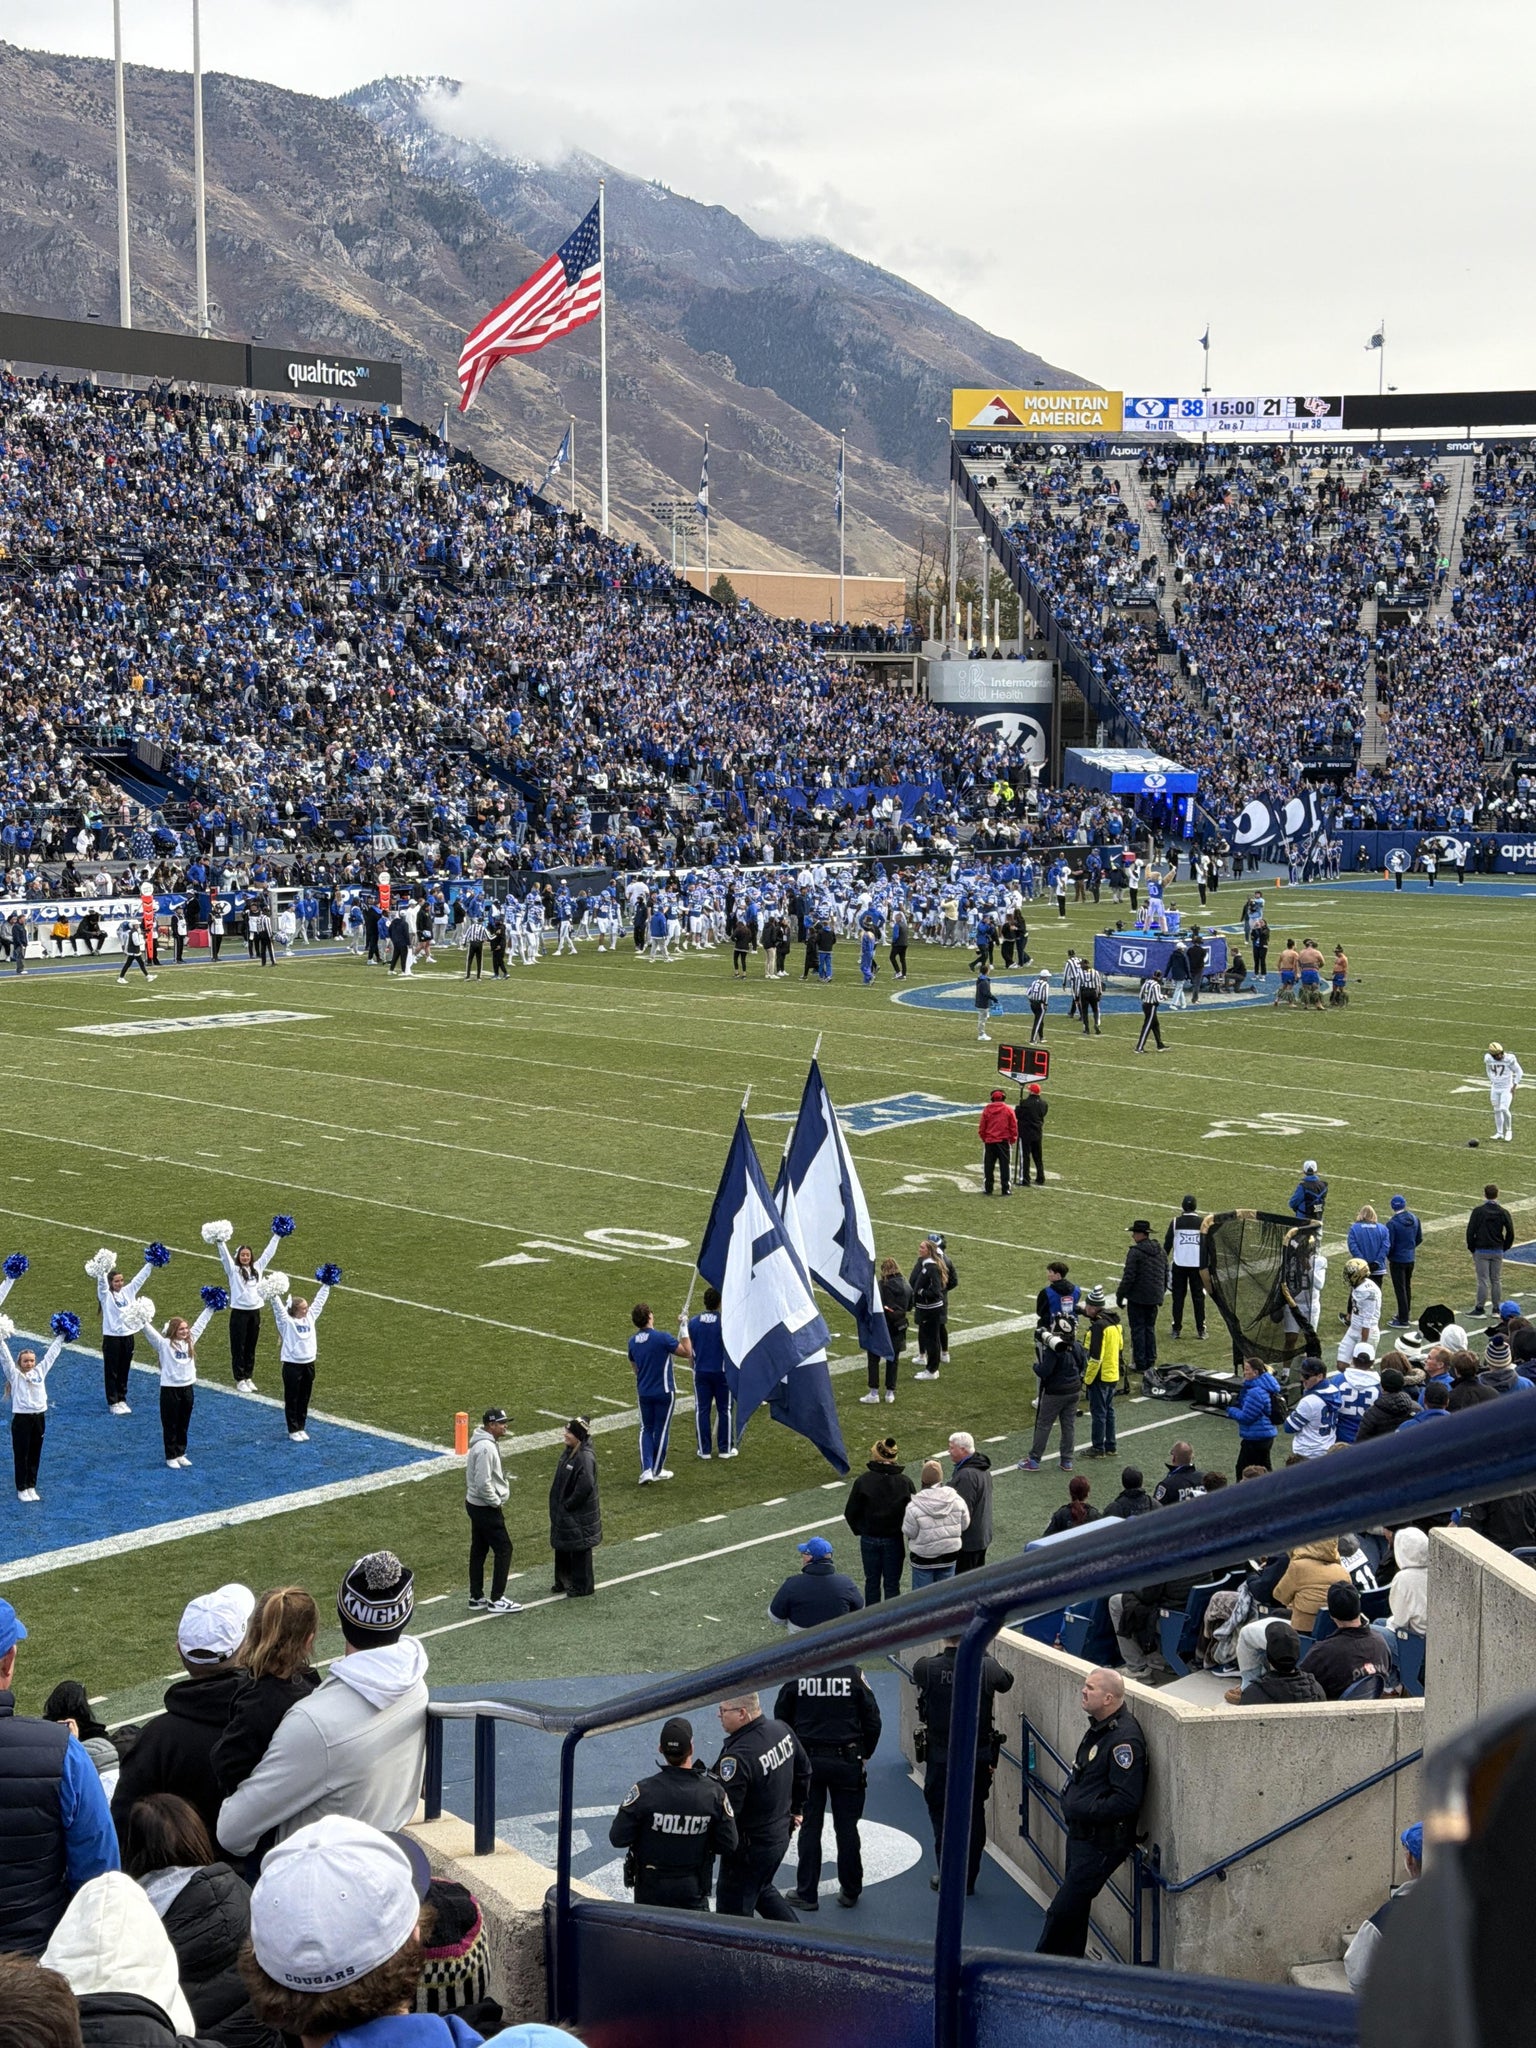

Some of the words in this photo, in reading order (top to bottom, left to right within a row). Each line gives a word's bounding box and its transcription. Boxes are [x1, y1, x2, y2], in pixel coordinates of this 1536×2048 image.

[288, 359, 357, 388] qualtrics
[1024, 396, 1109, 410] MOUNTAIN
[1181, 399, 1204, 417] 38
[1211, 400, 1255, 416] 15:00
[1263, 399, 1282, 416] 21
[1028, 411, 1103, 425] AMERICA
[1311, 419, 1322, 429] 38
[1446, 441, 1484, 454] smart
[991, 689, 1024, 700] Health
[999, 1045, 1048, 1077] 3:19
[1490, 1064, 1505, 1077] 47
[1208, 1112, 1350, 1136] 30
[516, 1227, 691, 1262] 10
[1339, 1381, 1380, 1417] 23
[1355, 1564, 1379, 1591] 11
[798, 1677, 852, 1697] POLICE
[758, 1733, 794, 1776] POLICE
[651, 1812, 711, 1835] POLICE
[285, 1965, 356, 1986] COUGARS
